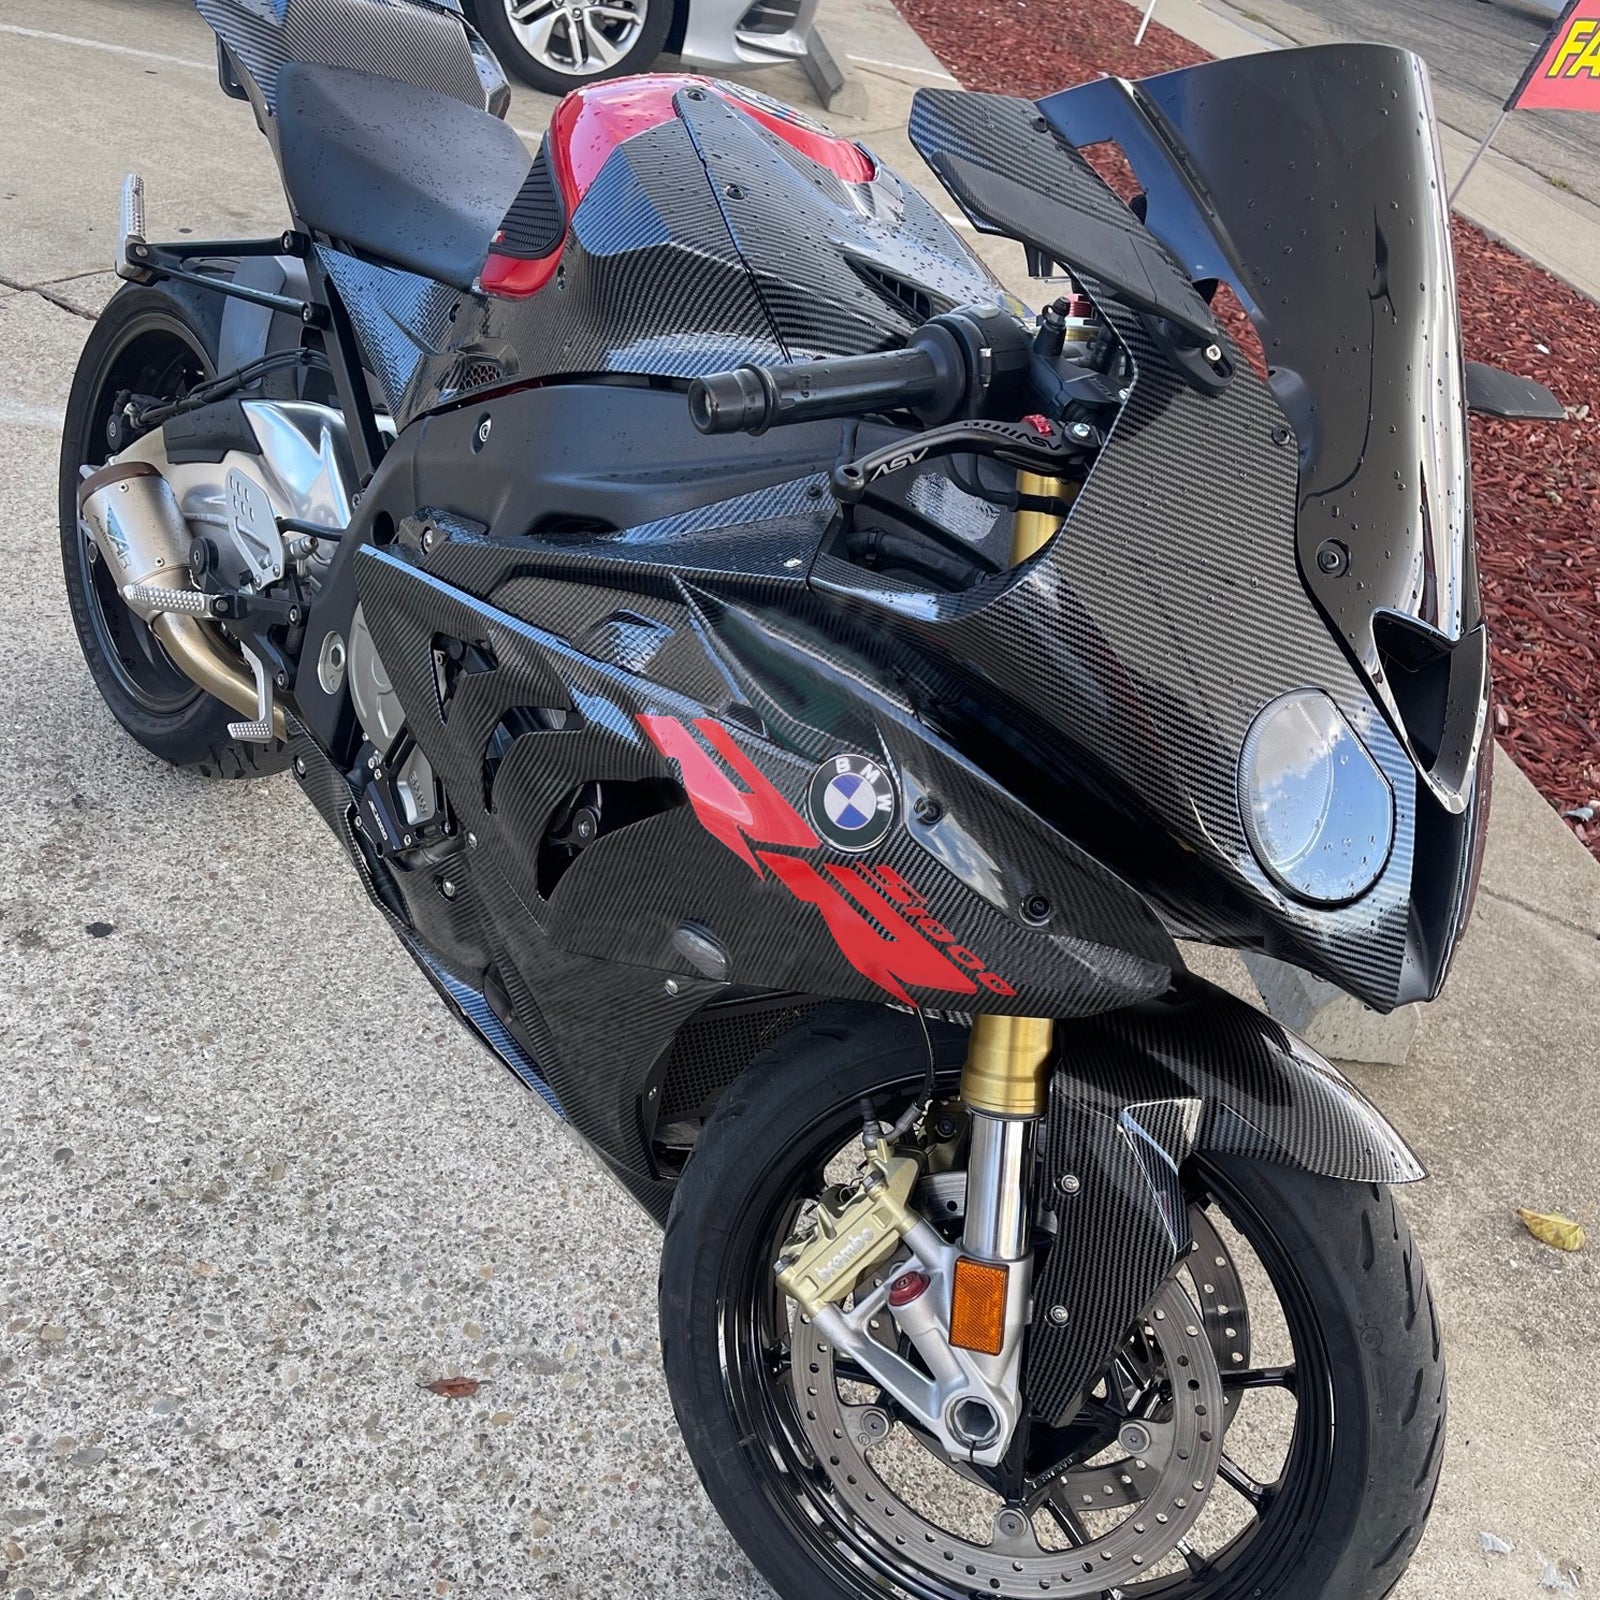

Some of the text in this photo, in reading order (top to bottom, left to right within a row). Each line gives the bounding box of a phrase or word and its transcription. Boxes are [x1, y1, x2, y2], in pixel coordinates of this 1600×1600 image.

[870, 447, 929, 482] ASV
[835, 757, 892, 813] BMW
[814, 1227, 875, 1284] brembo
